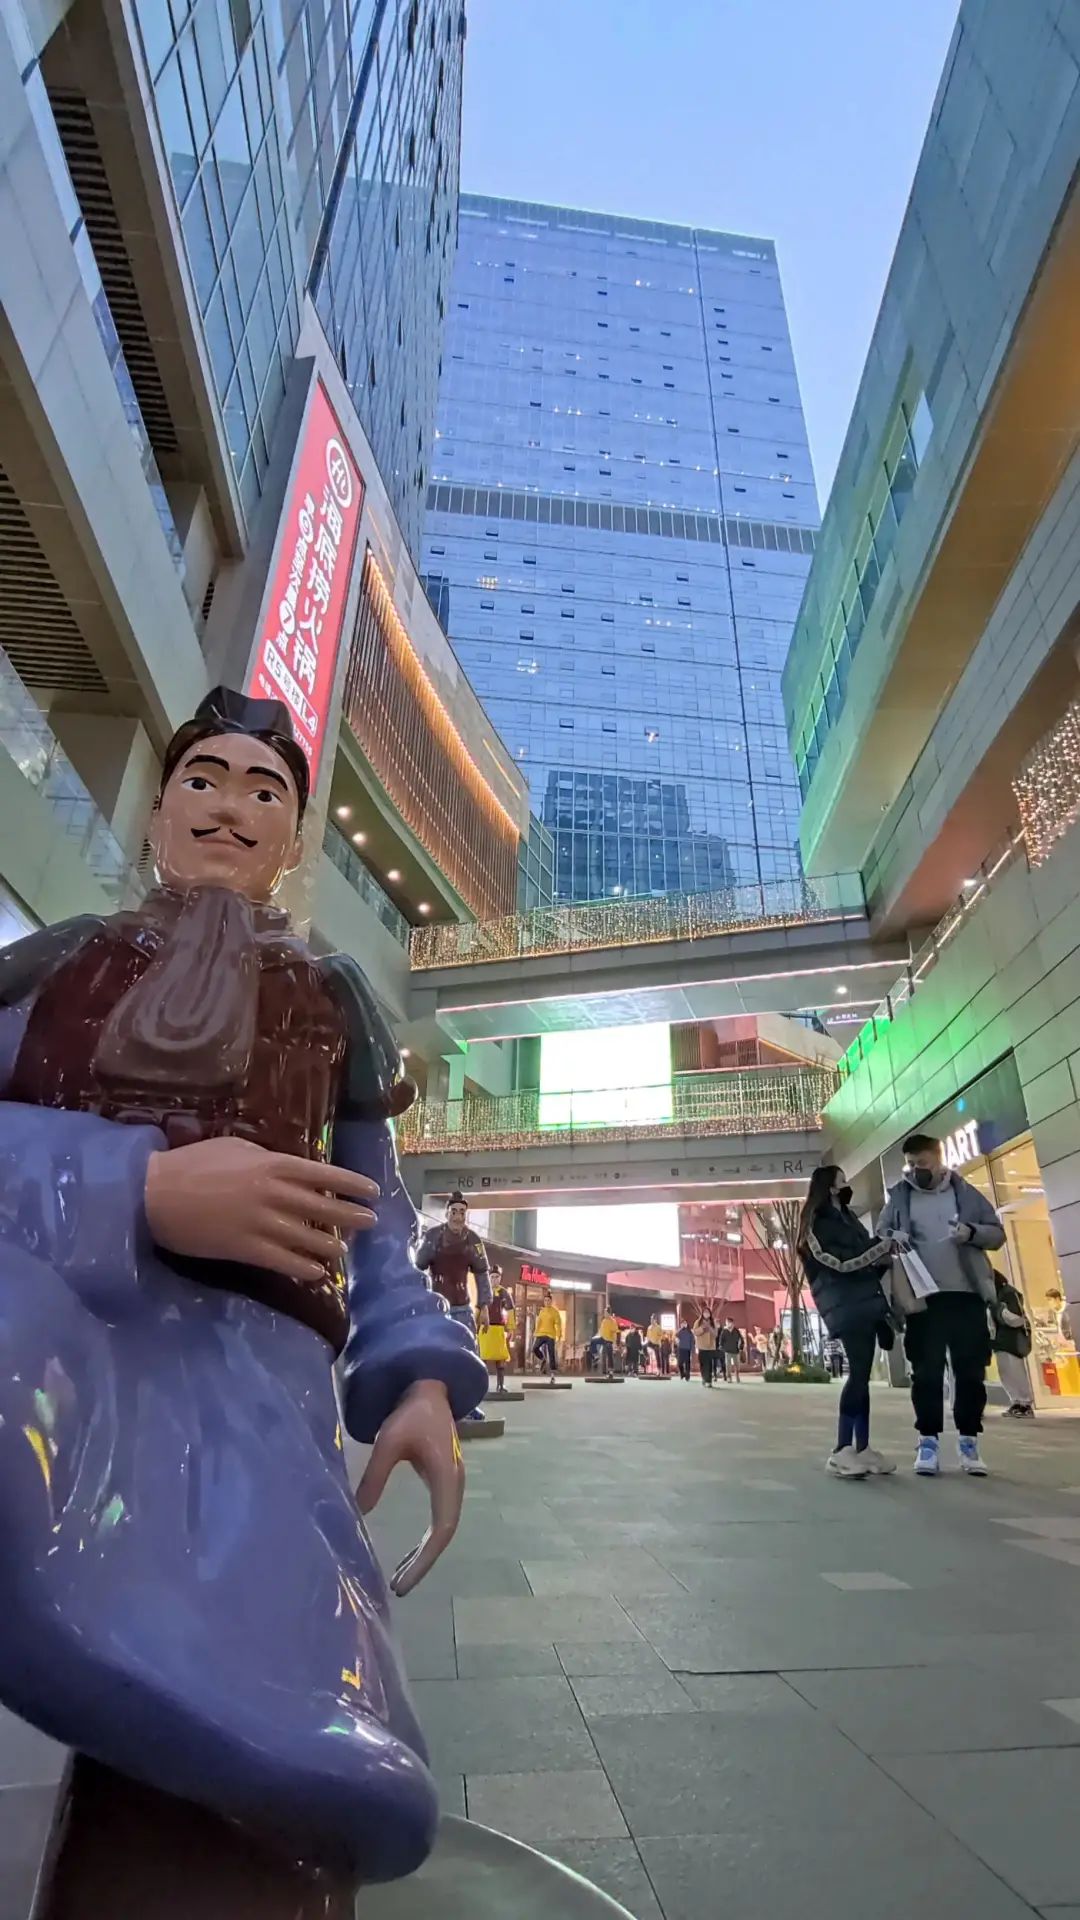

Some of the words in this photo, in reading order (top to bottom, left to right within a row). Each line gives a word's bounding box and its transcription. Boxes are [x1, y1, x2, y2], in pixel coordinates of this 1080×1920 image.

[293, 484, 343, 695] 海底捞火锅
[784, 1160, 803, 1173] R4
[458, 1176, 474, 1188] R6
